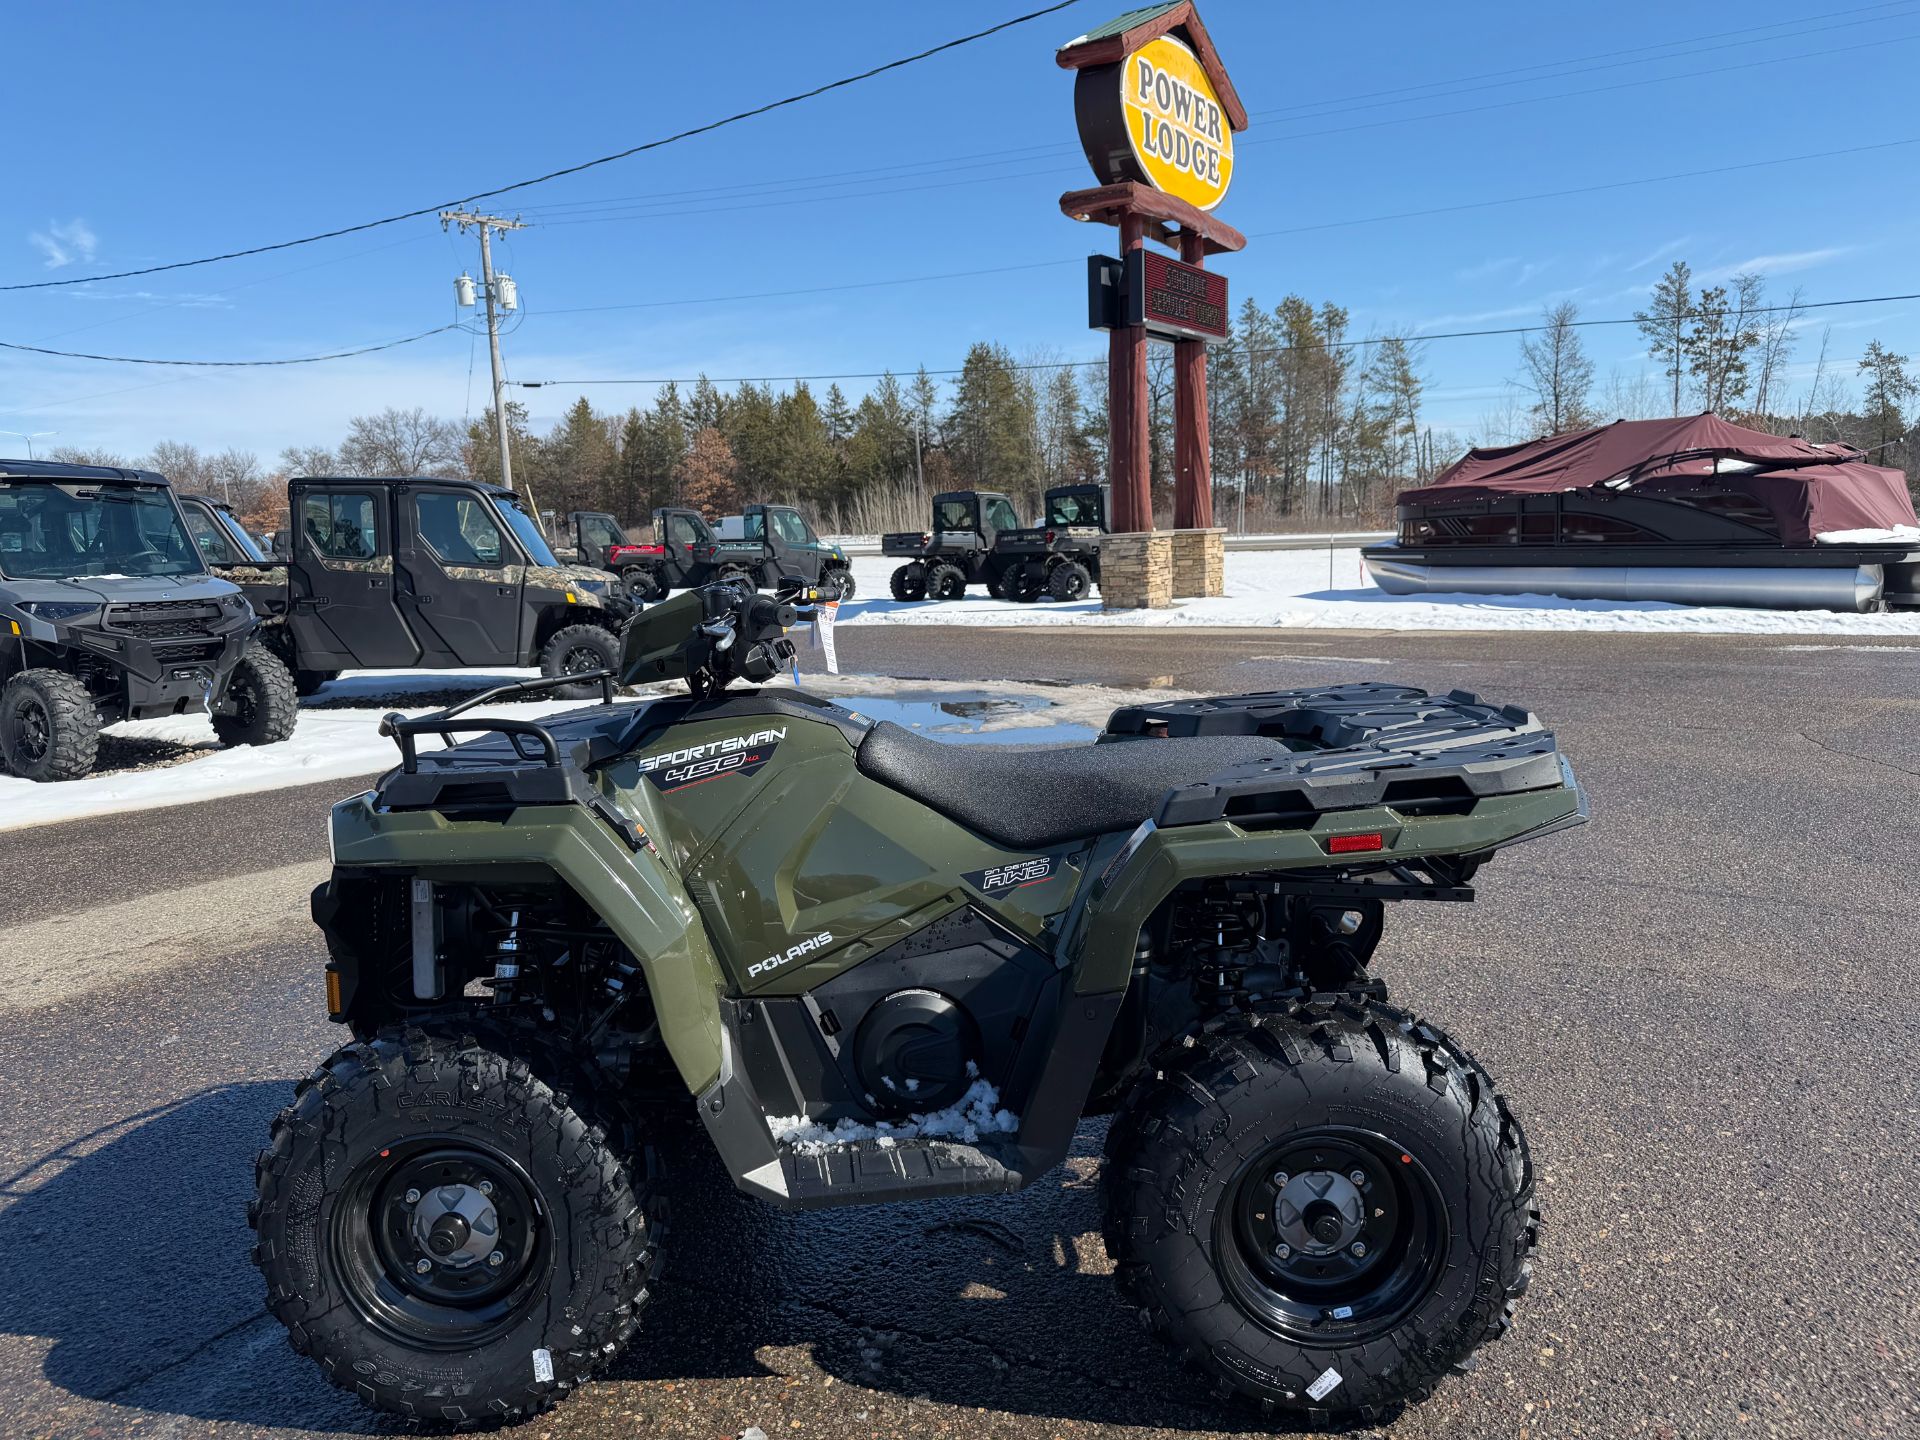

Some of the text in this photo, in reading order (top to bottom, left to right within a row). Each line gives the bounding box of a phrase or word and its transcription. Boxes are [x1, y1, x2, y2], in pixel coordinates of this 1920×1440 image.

[1137, 58, 1222, 144] POWER
[1142, 111, 1220, 184] LODGE
[1152, 289, 1189, 319] SERVICE
[638, 726, 787, 773] SPORTSMAN
[665, 751, 747, 781] 450
[983, 863, 1051, 889] AWD
[1004, 857, 1050, 872] DEMAND
[747, 931, 834, 978] POLARIS
[397, 1090, 534, 1136] CARLSTAR
